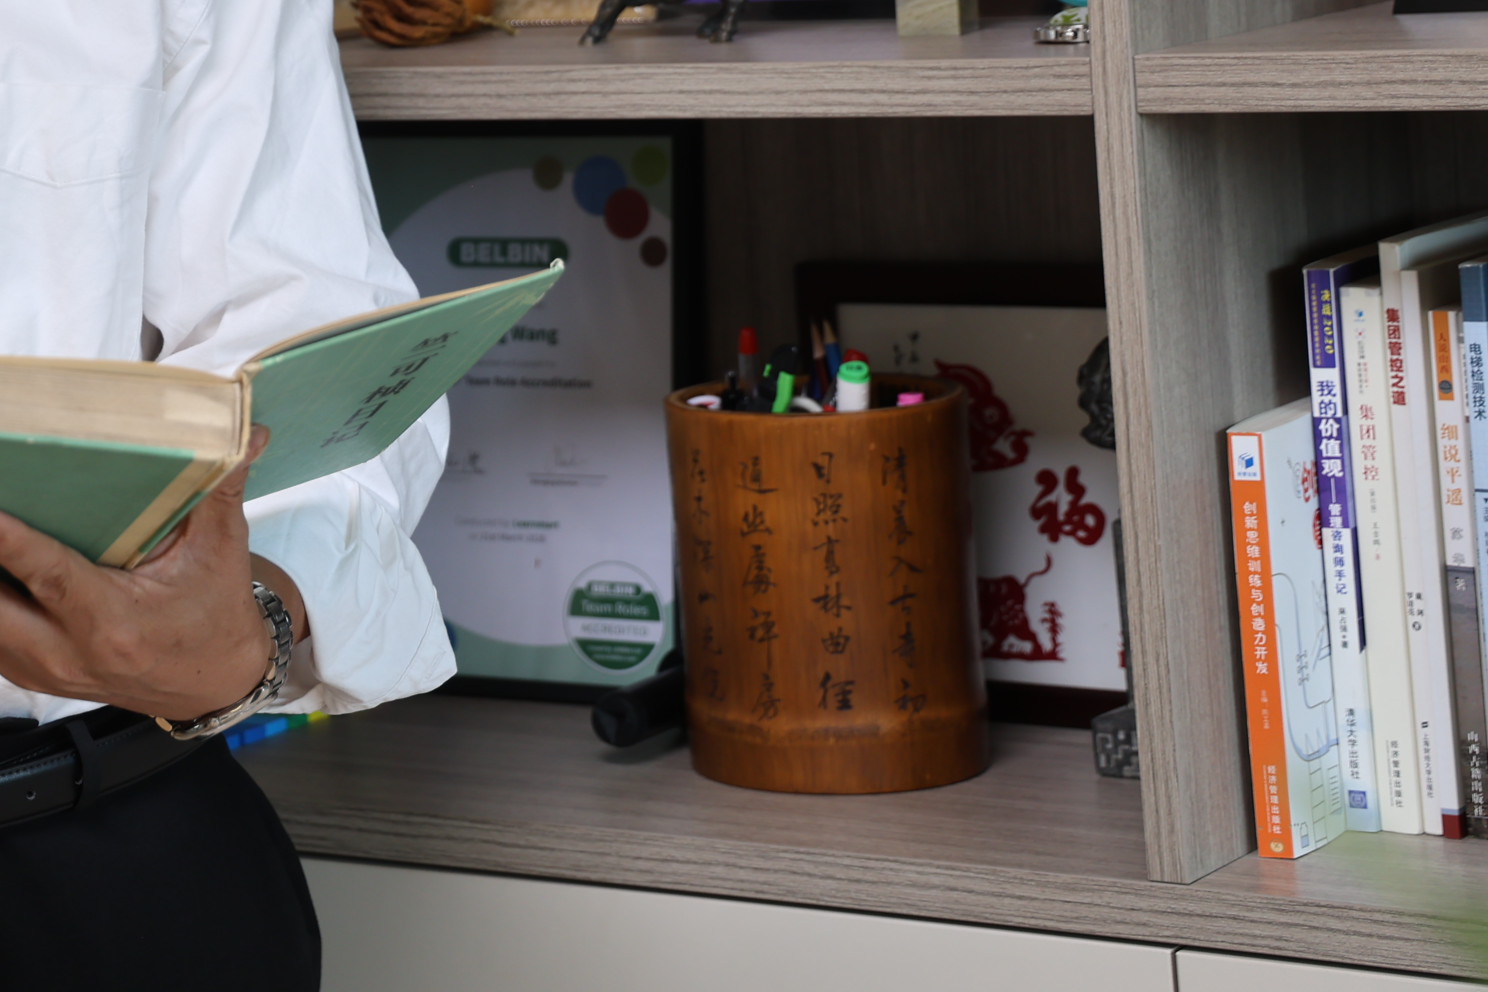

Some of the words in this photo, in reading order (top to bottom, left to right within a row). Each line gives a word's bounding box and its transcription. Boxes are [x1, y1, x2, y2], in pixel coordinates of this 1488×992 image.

[460, 240, 550, 264] BELBIN
[511, 326, 558, 346] Wang
[1385, 308, 1407, 407] 集团管控之道
[1469, 343, 1488, 421] 电梯检测技术
[1359, 404, 1380, 482] 集团管控
[1440, 423, 1465, 506] 细说平遥
[1030, 465, 1106, 546] 福
[1242, 500, 1269, 675] 创新思维训练与创造力开发
[1345, 708, 1361, 780] 清华大学出版社
[1390, 740, 1404, 808] 经济管理出版社
[1267, 765, 1283, 834] 经济管理出版社
